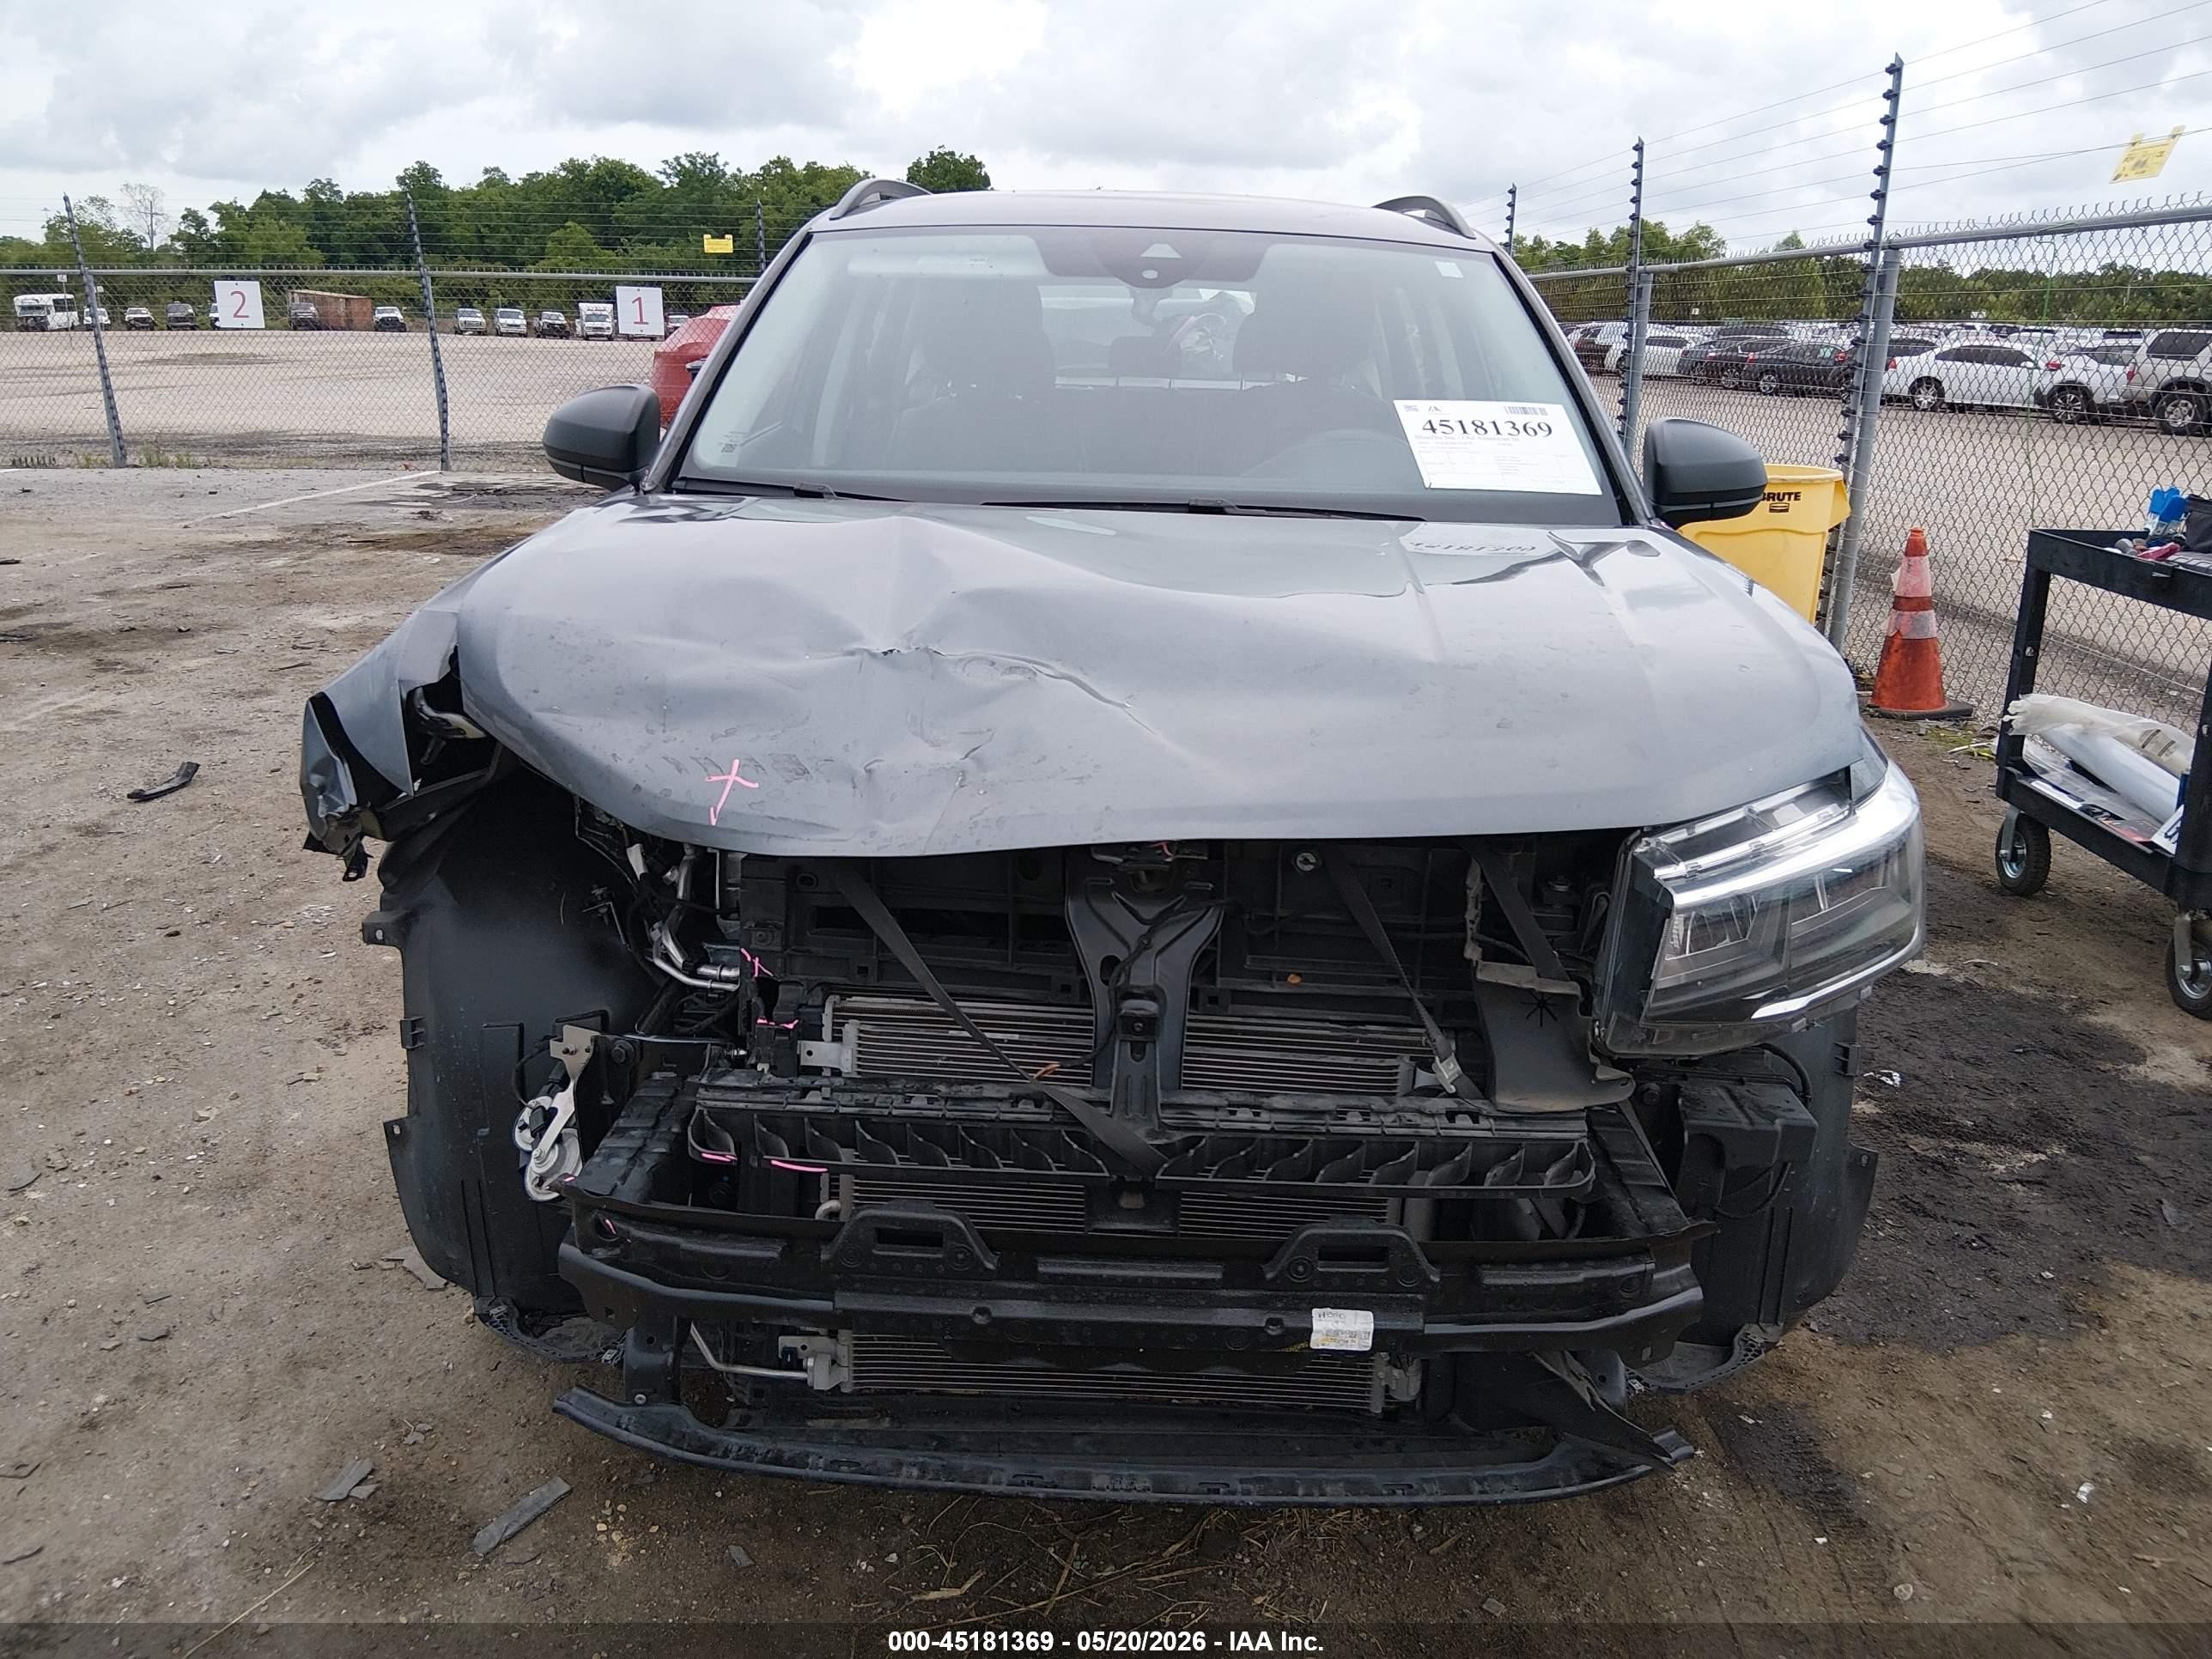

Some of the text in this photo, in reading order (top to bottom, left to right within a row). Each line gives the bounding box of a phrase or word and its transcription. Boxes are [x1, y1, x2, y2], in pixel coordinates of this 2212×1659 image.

[230, 290, 250, 319] 2
[631, 296, 649, 325] 1
[1422, 418, 1553, 439] 45181369
